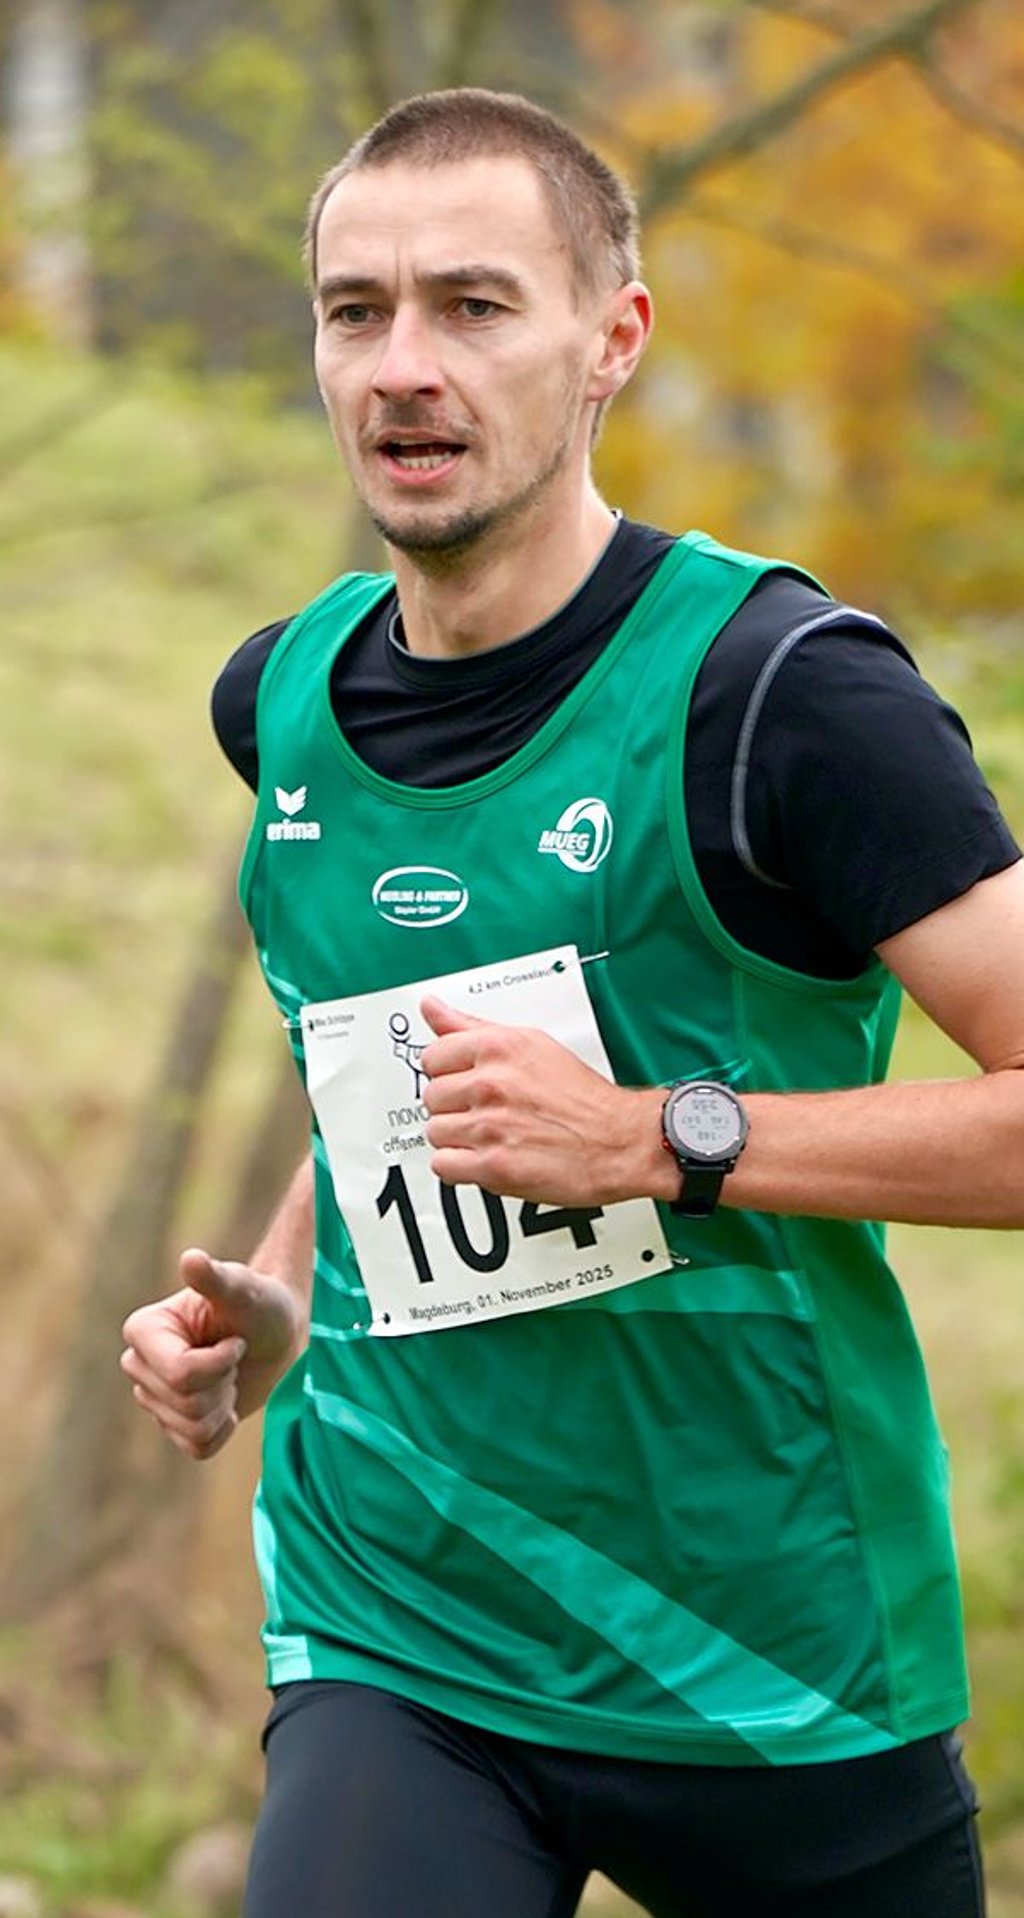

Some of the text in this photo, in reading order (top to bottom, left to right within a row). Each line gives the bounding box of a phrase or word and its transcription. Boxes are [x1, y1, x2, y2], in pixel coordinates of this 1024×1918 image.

[266, 818, 321, 842] erima
[538, 831, 590, 850] MUEG
[503, 968, 555, 986] Crosslau
[499, 1278, 571, 1303] November
[575, 1264, 614, 1286] 2025
